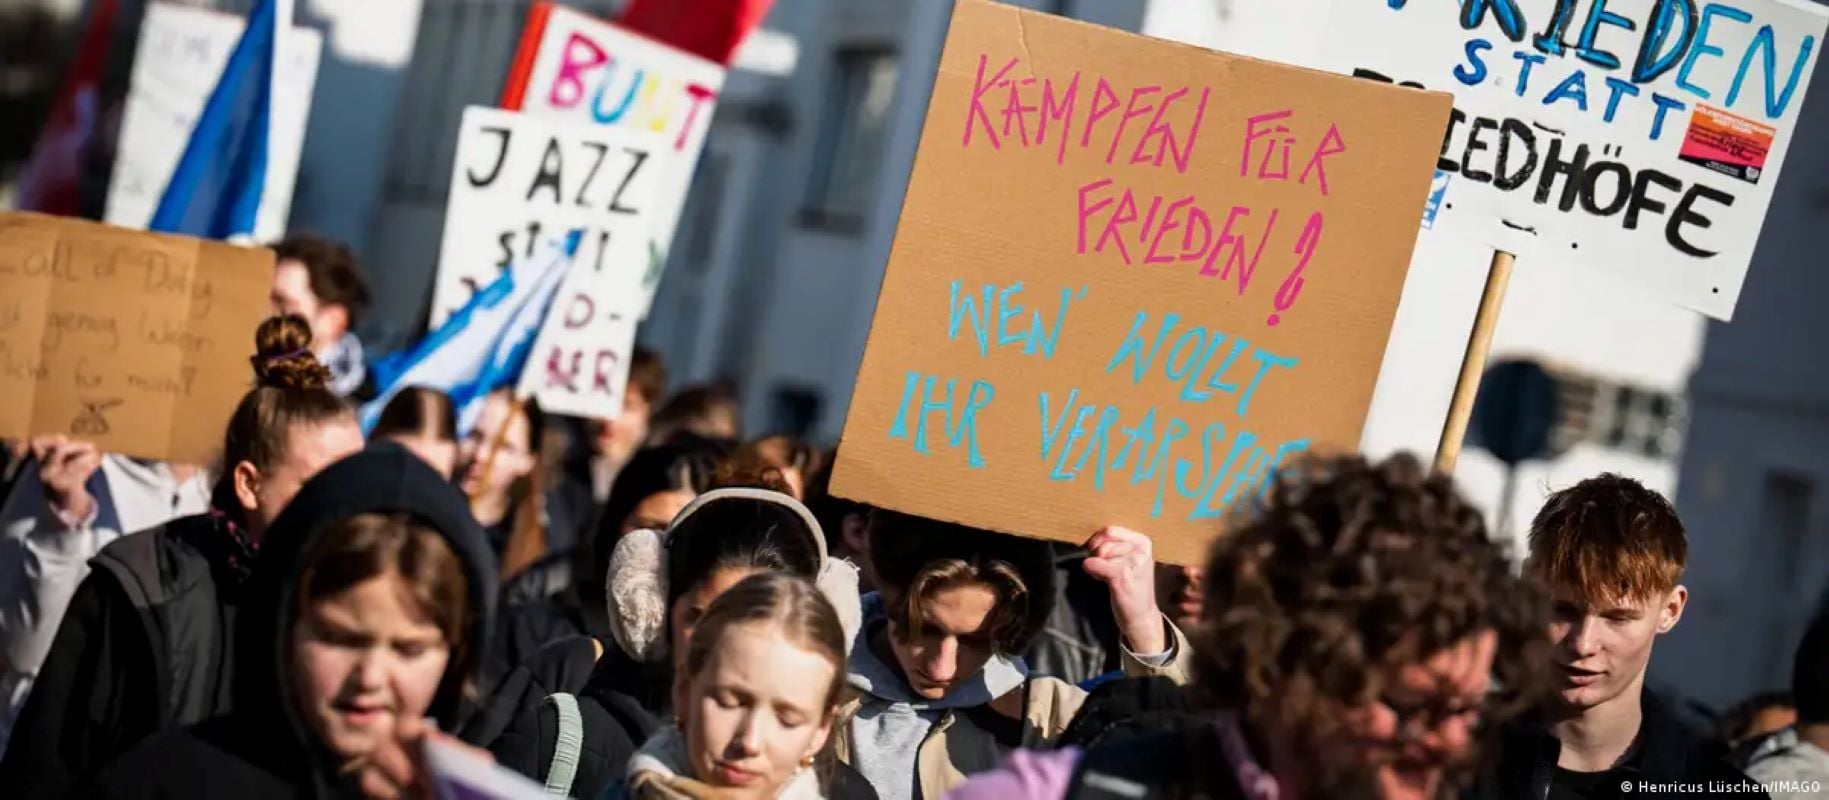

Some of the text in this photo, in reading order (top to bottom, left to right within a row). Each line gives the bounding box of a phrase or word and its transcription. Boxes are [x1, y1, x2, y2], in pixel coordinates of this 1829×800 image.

[549, 31, 718, 153] BUNT
[1387, 0, 1815, 119] IEDEN
[1453, 38, 1686, 141] STATT
[467, 126, 650, 215] JAZZ
[963, 54, 1346, 196] KÄMPFEN FÜR
[1353, 68, 1736, 259] IEDHÖFE
[888, 370, 996, 470] IHR
[1105, 311, 1301, 417] WOLLT
